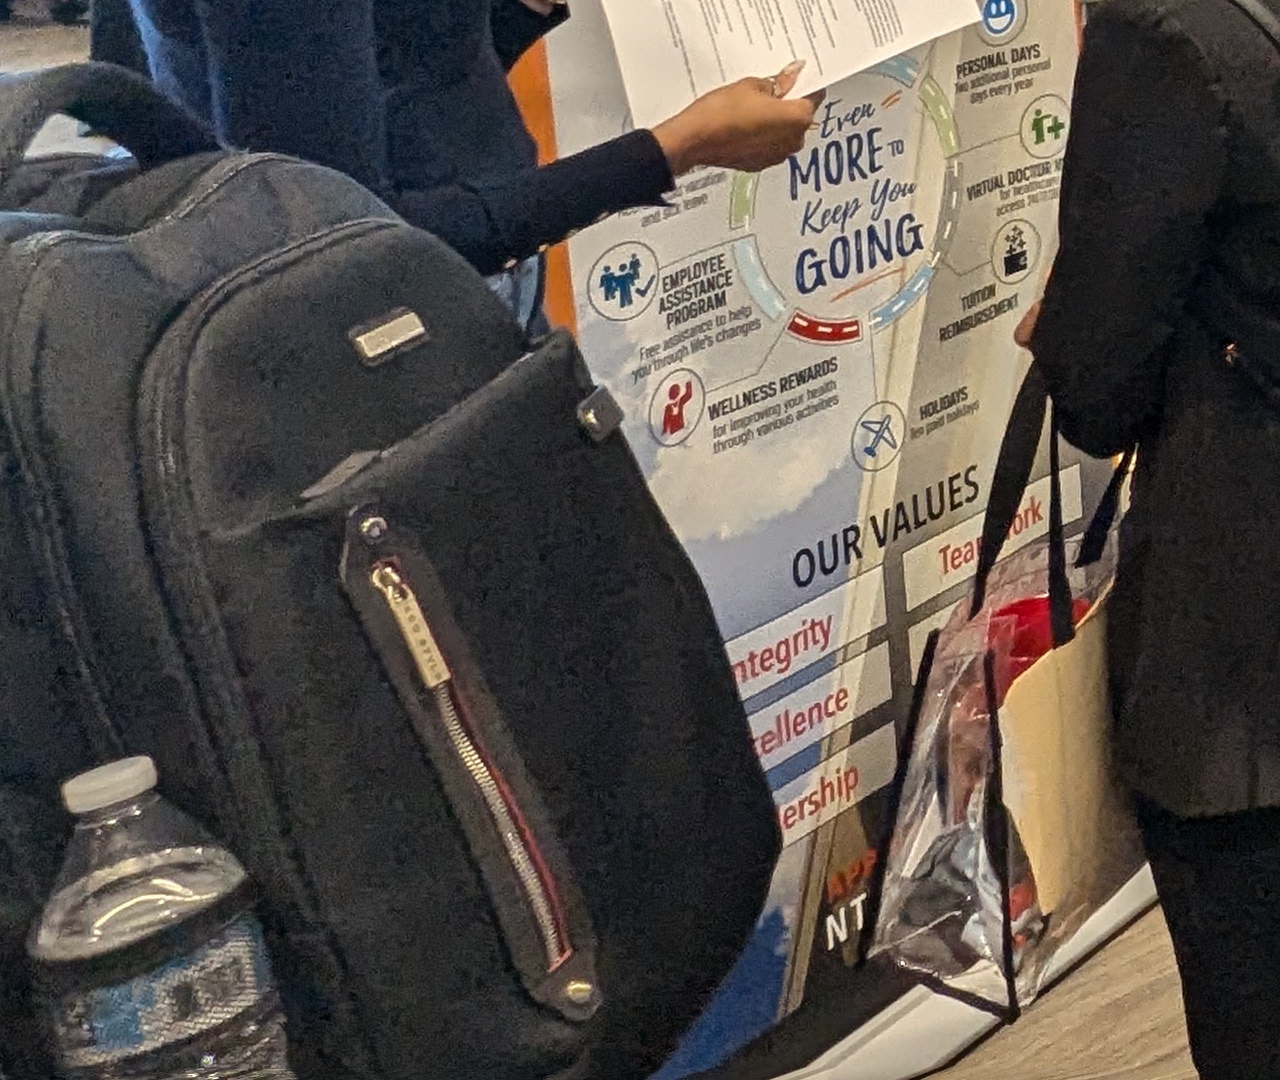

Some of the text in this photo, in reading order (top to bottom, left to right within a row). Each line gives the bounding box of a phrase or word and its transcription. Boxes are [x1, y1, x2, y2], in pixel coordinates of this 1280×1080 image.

[956, 44, 1040, 80] PERSONAL DAYS
[821, 99, 876, 138] Even
[788, 127, 884, 201] MORE
[801, 178, 916, 236] Keep You
[967, 174, 1005, 201] VIRTUAL
[662, 253, 726, 293] EMPLOYEE
[795, 213, 924, 294] GOING
[659, 270, 734, 314] ASSISTANCE
[667, 291, 727, 330] PROGRAM
[631, 362, 652, 385] you
[653, 343, 691, 373] through
[715, 318, 762, 344] changes
[640, 343, 661, 361] Free
[662, 320, 713, 351] assistance
[716, 313, 727, 328] to
[708, 356, 838, 421] WELLNESS REWARDS
[919, 386, 969, 421] HOLIDAYS
[713, 420, 728, 439] for
[730, 402, 781, 434] improving
[783, 392, 804, 414] your
[713, 426, 755, 455] through
[791, 464, 981, 588] OUR VALUES
